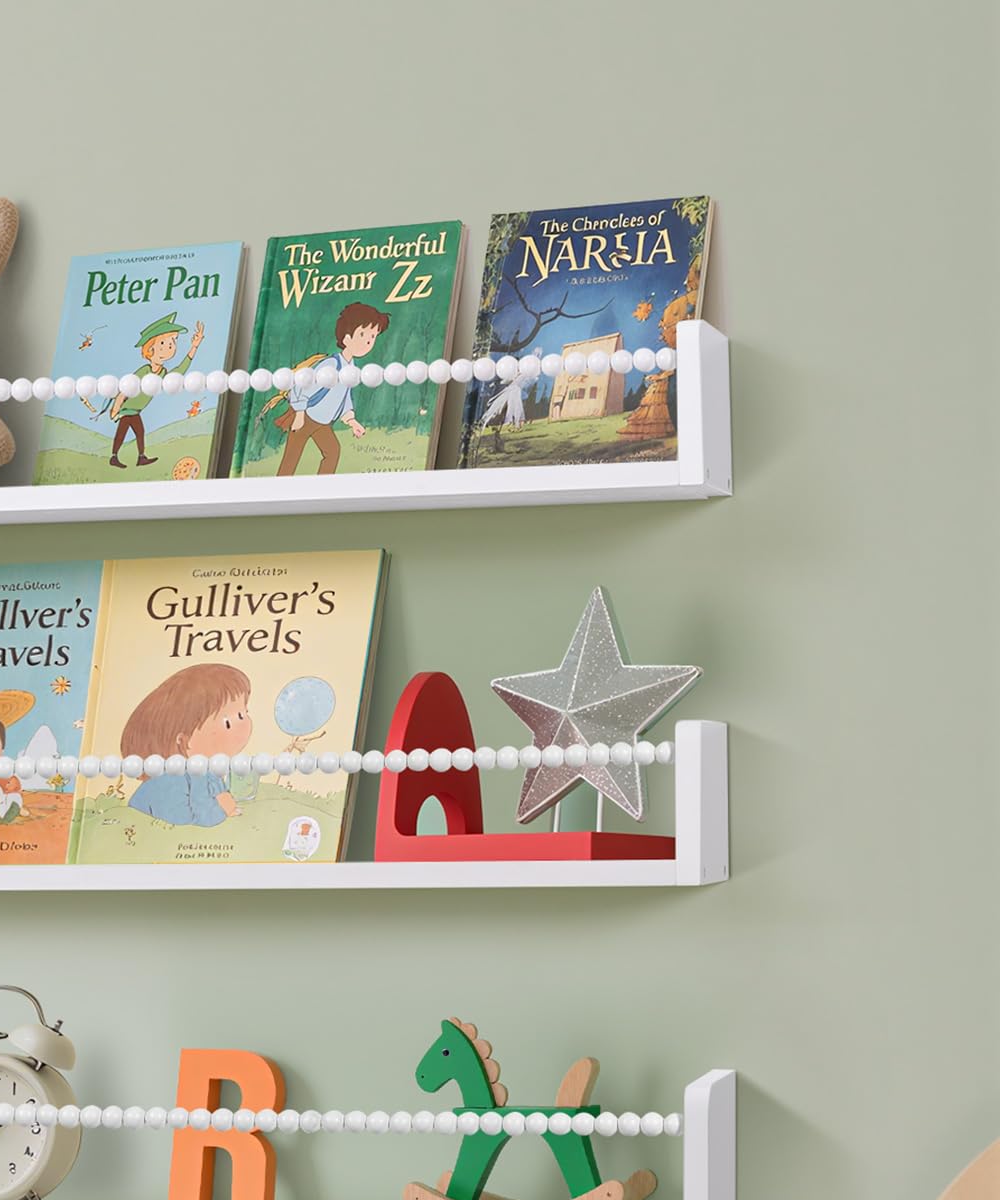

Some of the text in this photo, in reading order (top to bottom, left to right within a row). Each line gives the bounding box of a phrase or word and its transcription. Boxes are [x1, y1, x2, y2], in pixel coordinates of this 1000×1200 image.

[540, 219, 568, 236] The
[647, 209, 667, 226] of
[284, 231, 447, 267] The Wonderful
[82, 265, 221, 307] Peter Pan
[146, 582, 336, 621] Gulliver's
[164, 618, 302, 658] Travels
